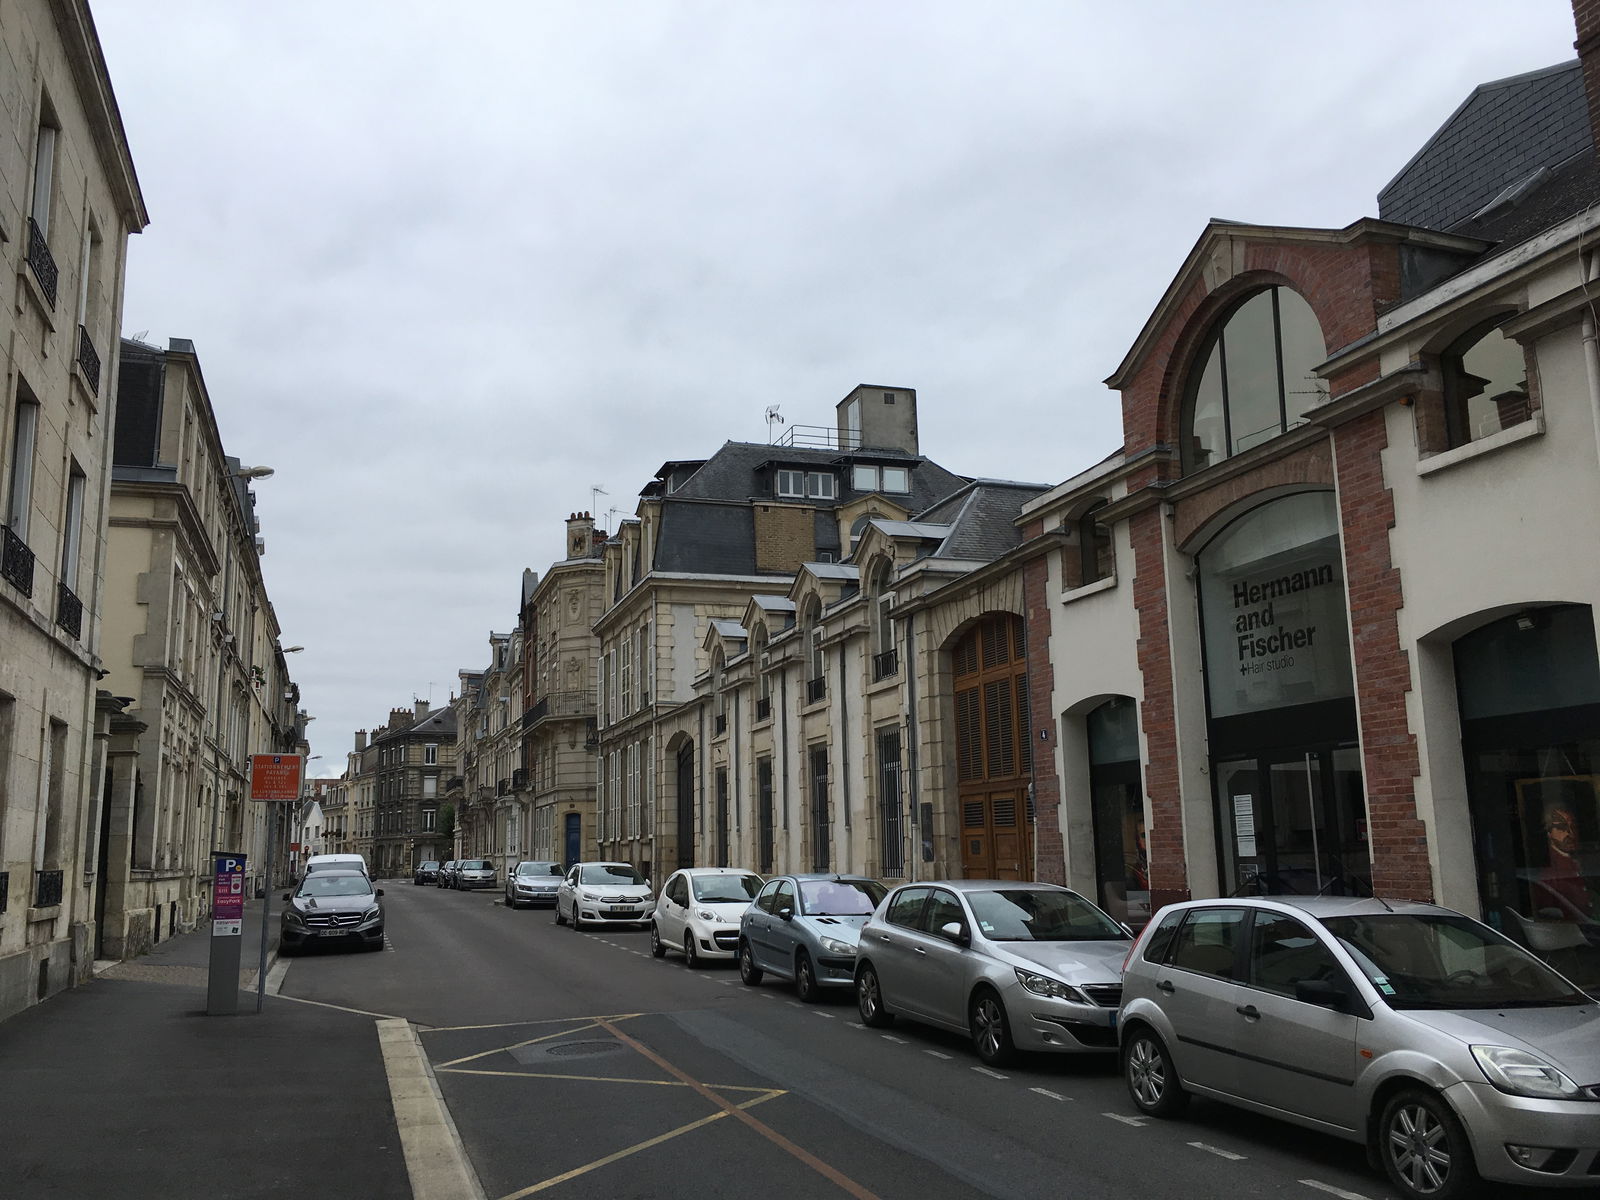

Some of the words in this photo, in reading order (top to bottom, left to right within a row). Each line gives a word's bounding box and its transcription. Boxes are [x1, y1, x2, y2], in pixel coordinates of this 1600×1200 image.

[1233, 564, 1333, 608] Hermann
[1236, 602, 1274, 633] and
[1237, 626, 1316, 661] Fischer
[1266, 655, 1295, 672] studio
[225, 859, 237, 872] P
